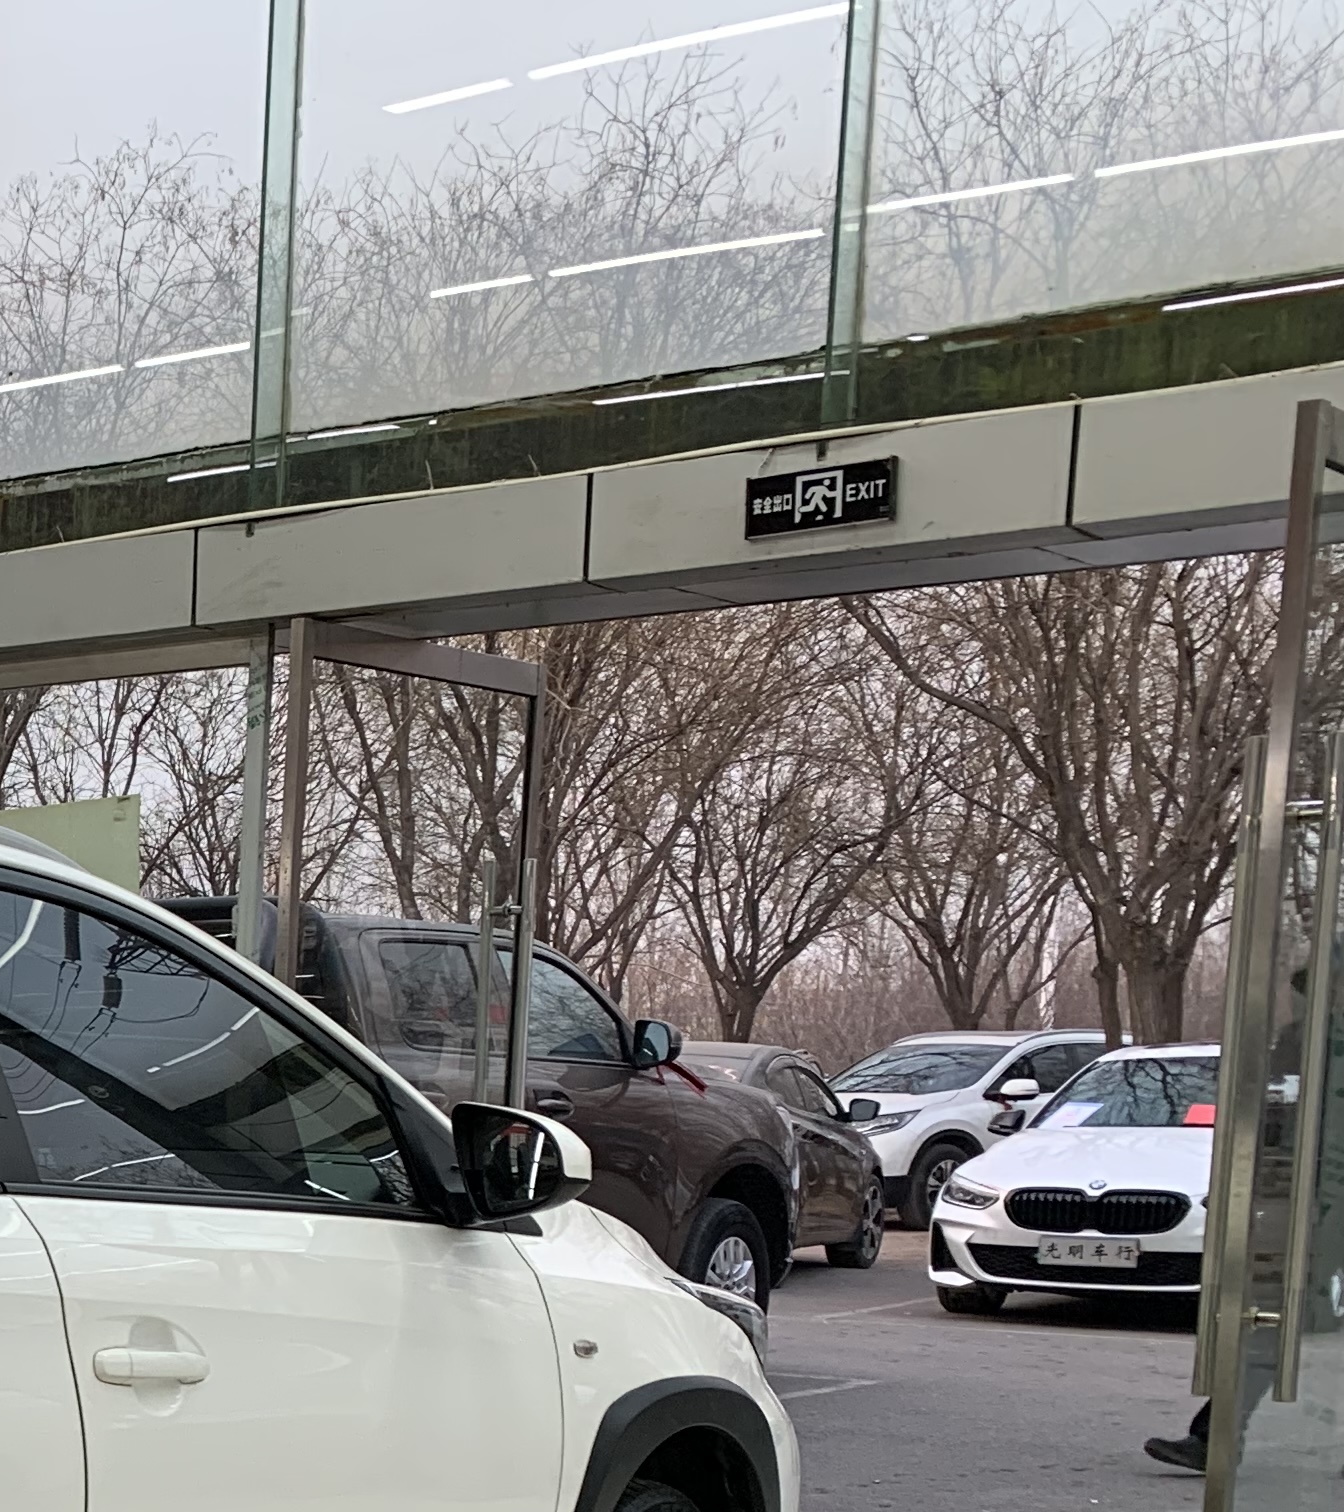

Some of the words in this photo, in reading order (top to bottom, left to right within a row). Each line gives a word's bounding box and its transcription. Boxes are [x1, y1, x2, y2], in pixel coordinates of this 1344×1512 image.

[752, 494, 793, 515] 安全出口
[845, 479, 886, 502] EXIT
